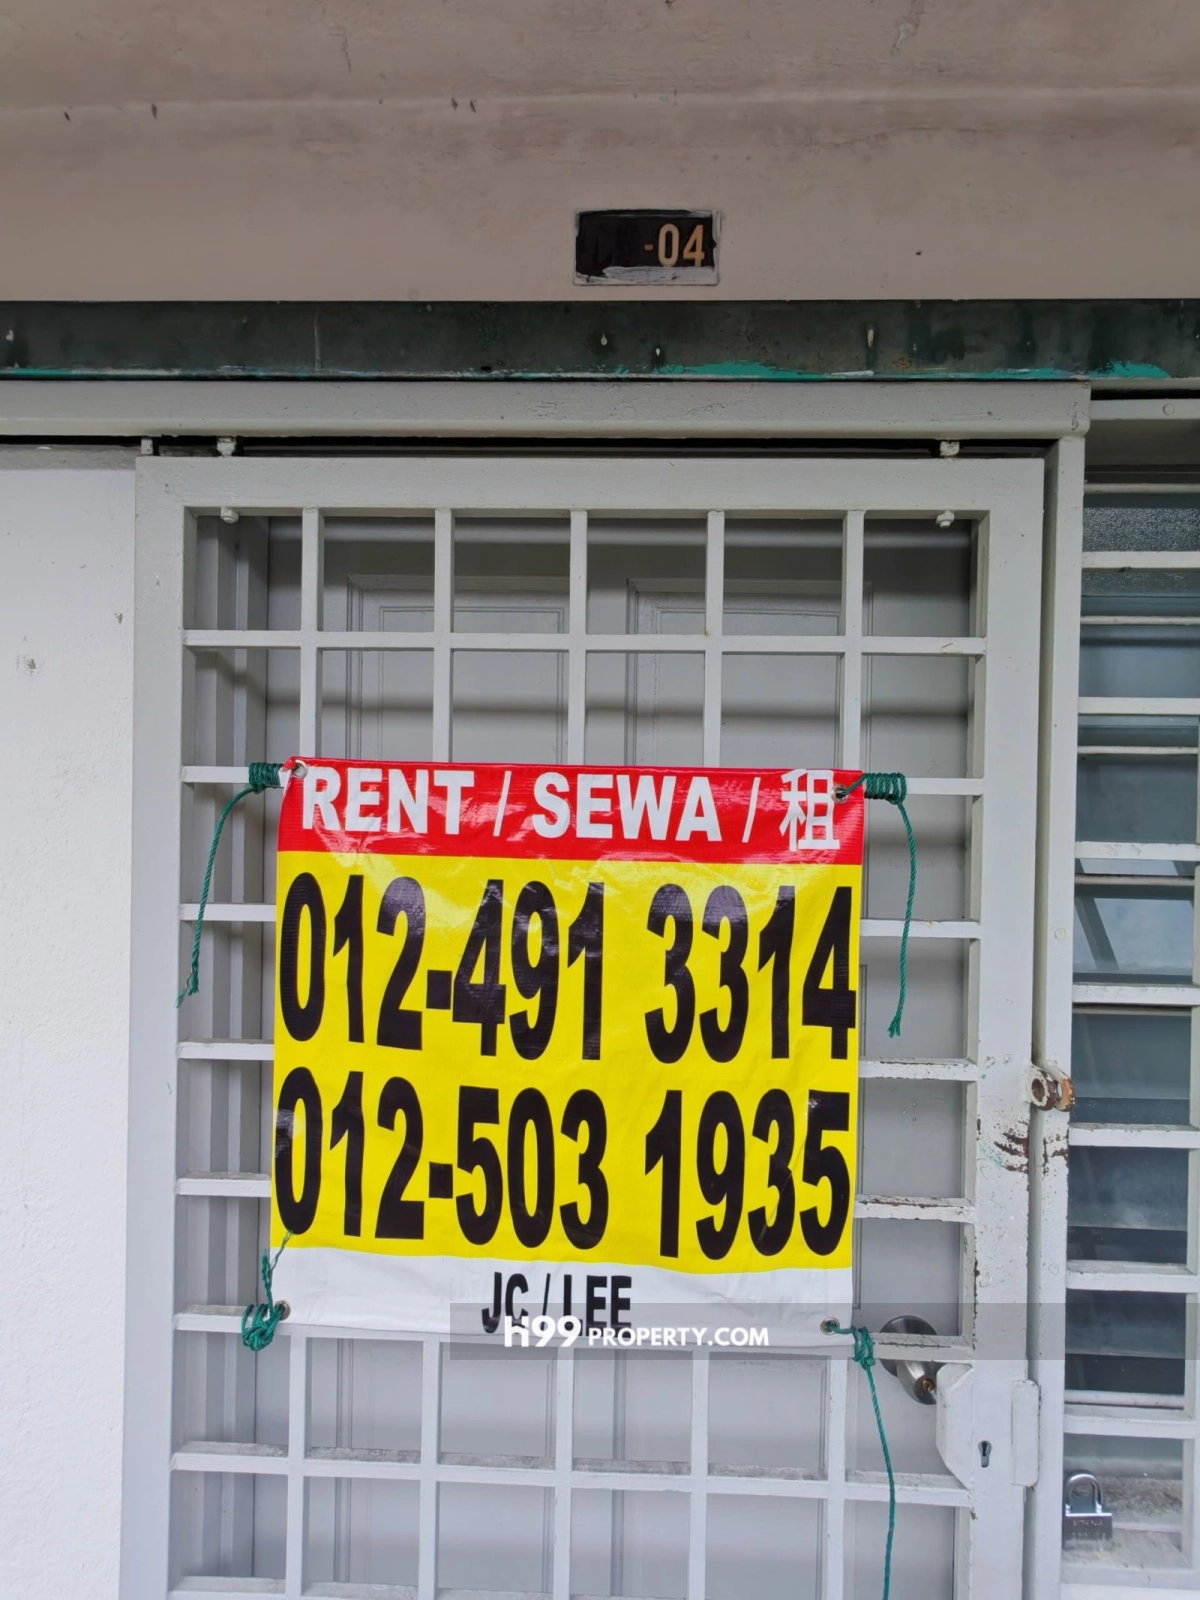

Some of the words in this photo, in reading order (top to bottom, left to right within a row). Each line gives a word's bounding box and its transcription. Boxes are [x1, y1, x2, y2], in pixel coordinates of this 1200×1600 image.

[302, 766, 475, 836] RENT
[493, 771, 512, 836] /
[532, 772, 721, 842] SEWA
[742, 777, 761, 844] /
[779, 769, 841, 851] 租
[279, 871, 605, 1061] 012-491
[645, 883, 857, 1064] 3314
[274, 1066, 609, 1250] 012-503
[644, 1088, 850, 1260] 1935
